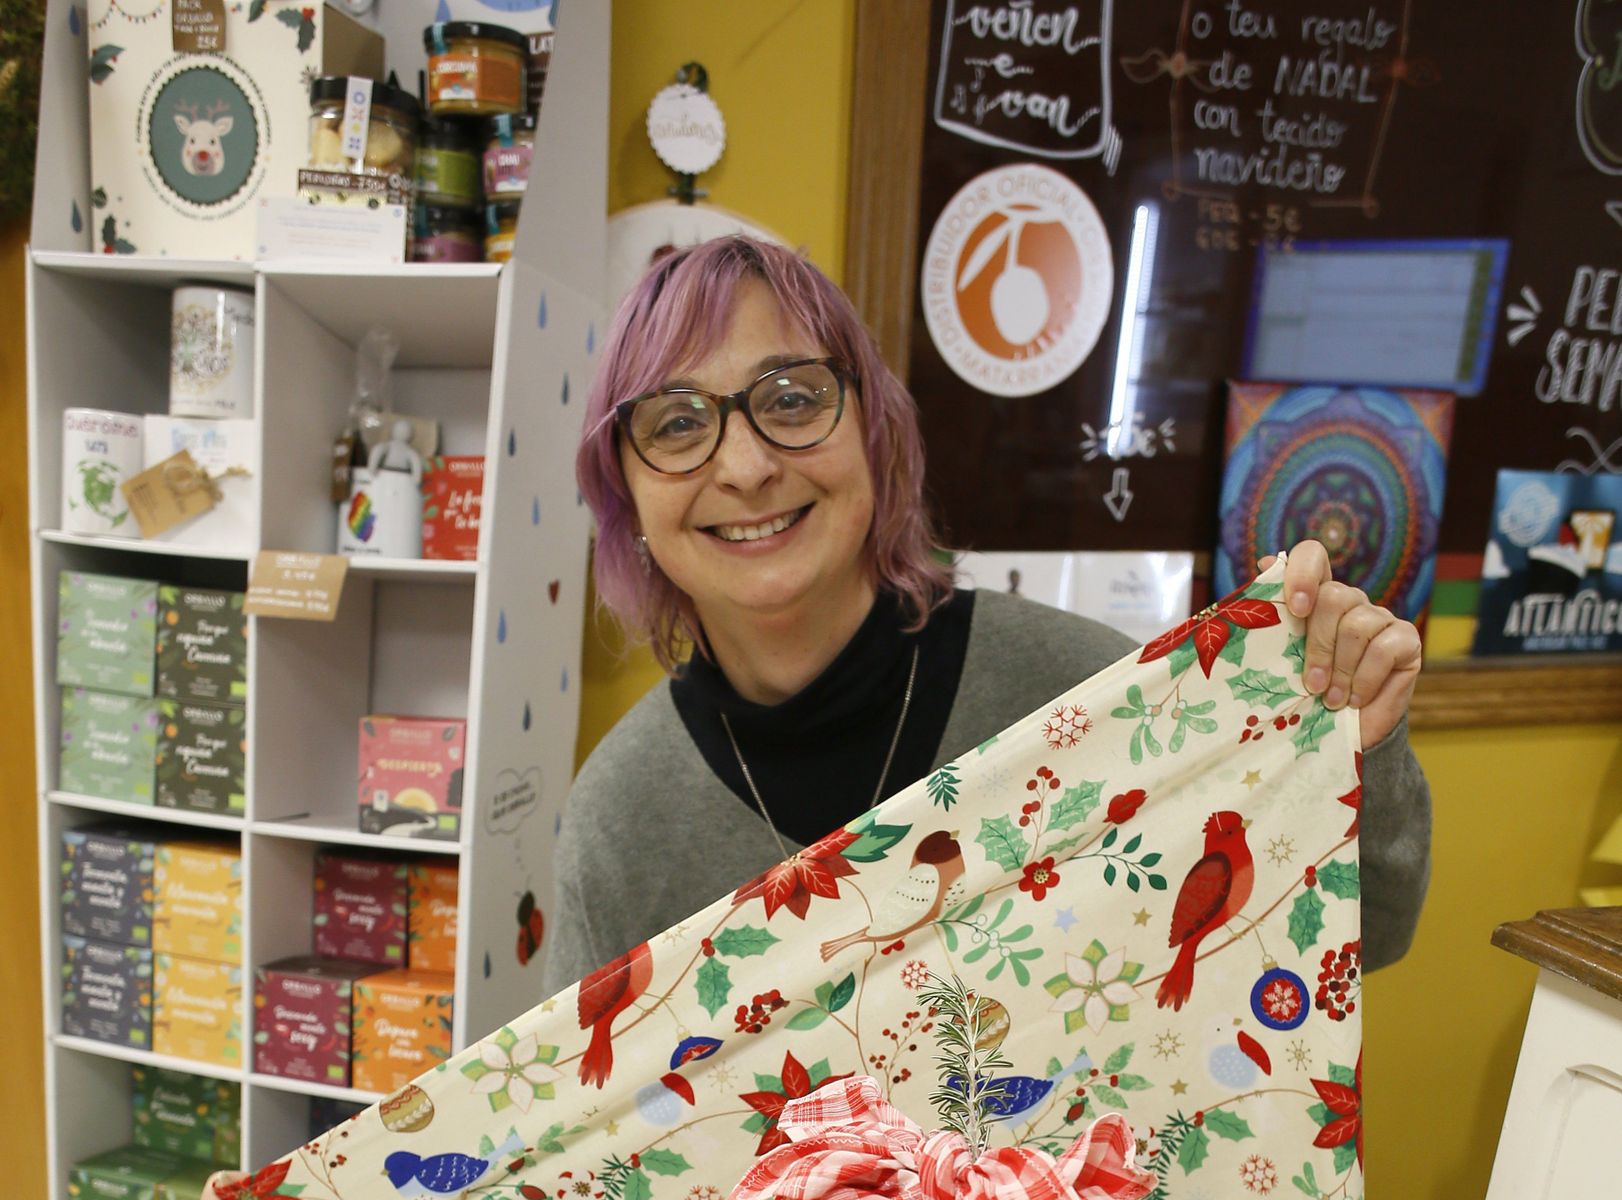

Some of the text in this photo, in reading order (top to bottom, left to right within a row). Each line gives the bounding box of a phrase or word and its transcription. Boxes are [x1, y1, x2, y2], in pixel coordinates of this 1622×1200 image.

[962, 0, 1090, 54] veñen
[1226, 0, 1277, 39] teu
[1302, 7, 1397, 66] regalo
[1209, 51, 1378, 102] de NADAL
[992, 91, 1085, 137] van
[1194, 100, 1348, 147] con tecido
[1194, 143, 1346, 193] navideño
[929, 187, 991, 345] DISTRIBUIDOR
[997, 173, 1079, 217] OFICIAL
